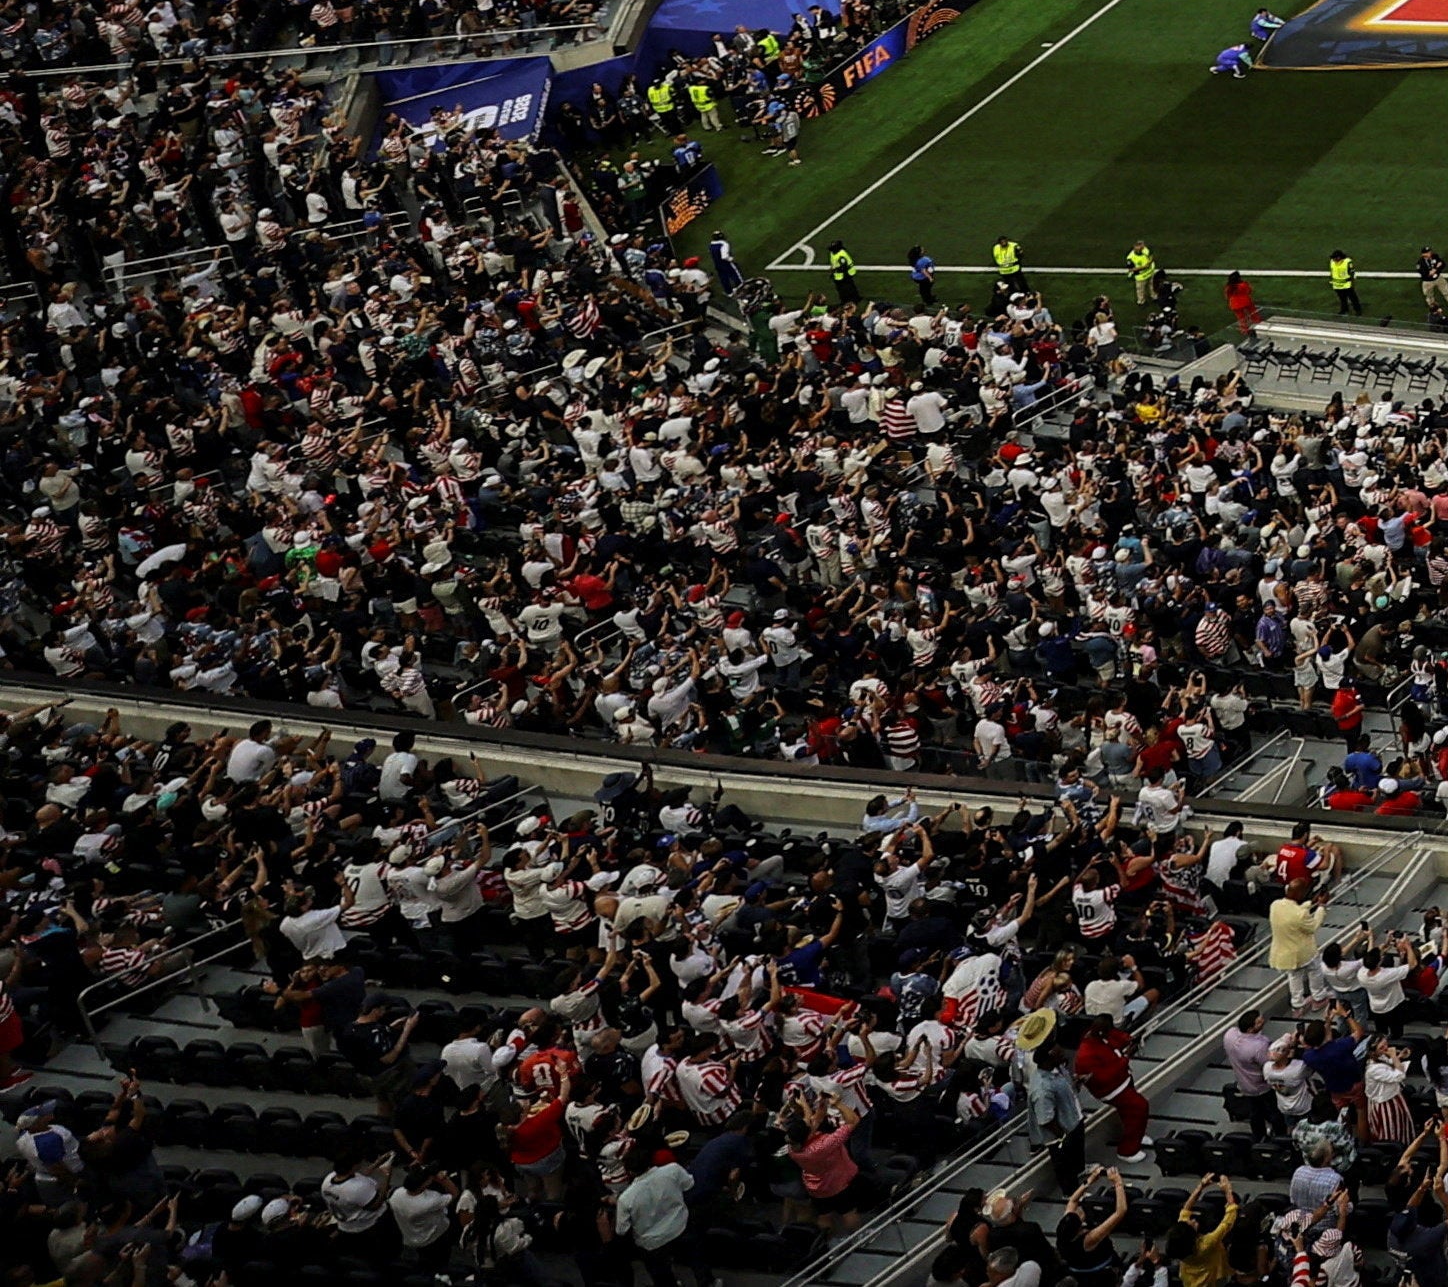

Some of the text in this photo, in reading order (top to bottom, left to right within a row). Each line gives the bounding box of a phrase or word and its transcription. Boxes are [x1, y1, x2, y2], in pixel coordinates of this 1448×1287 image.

[842, 45, 891, 88] FIFA
[533, 619, 549, 630] 10
[1186, 739, 1194, 751] 8
[1278, 863, 1287, 880] 4
[1077, 906, 1093, 919] 10
